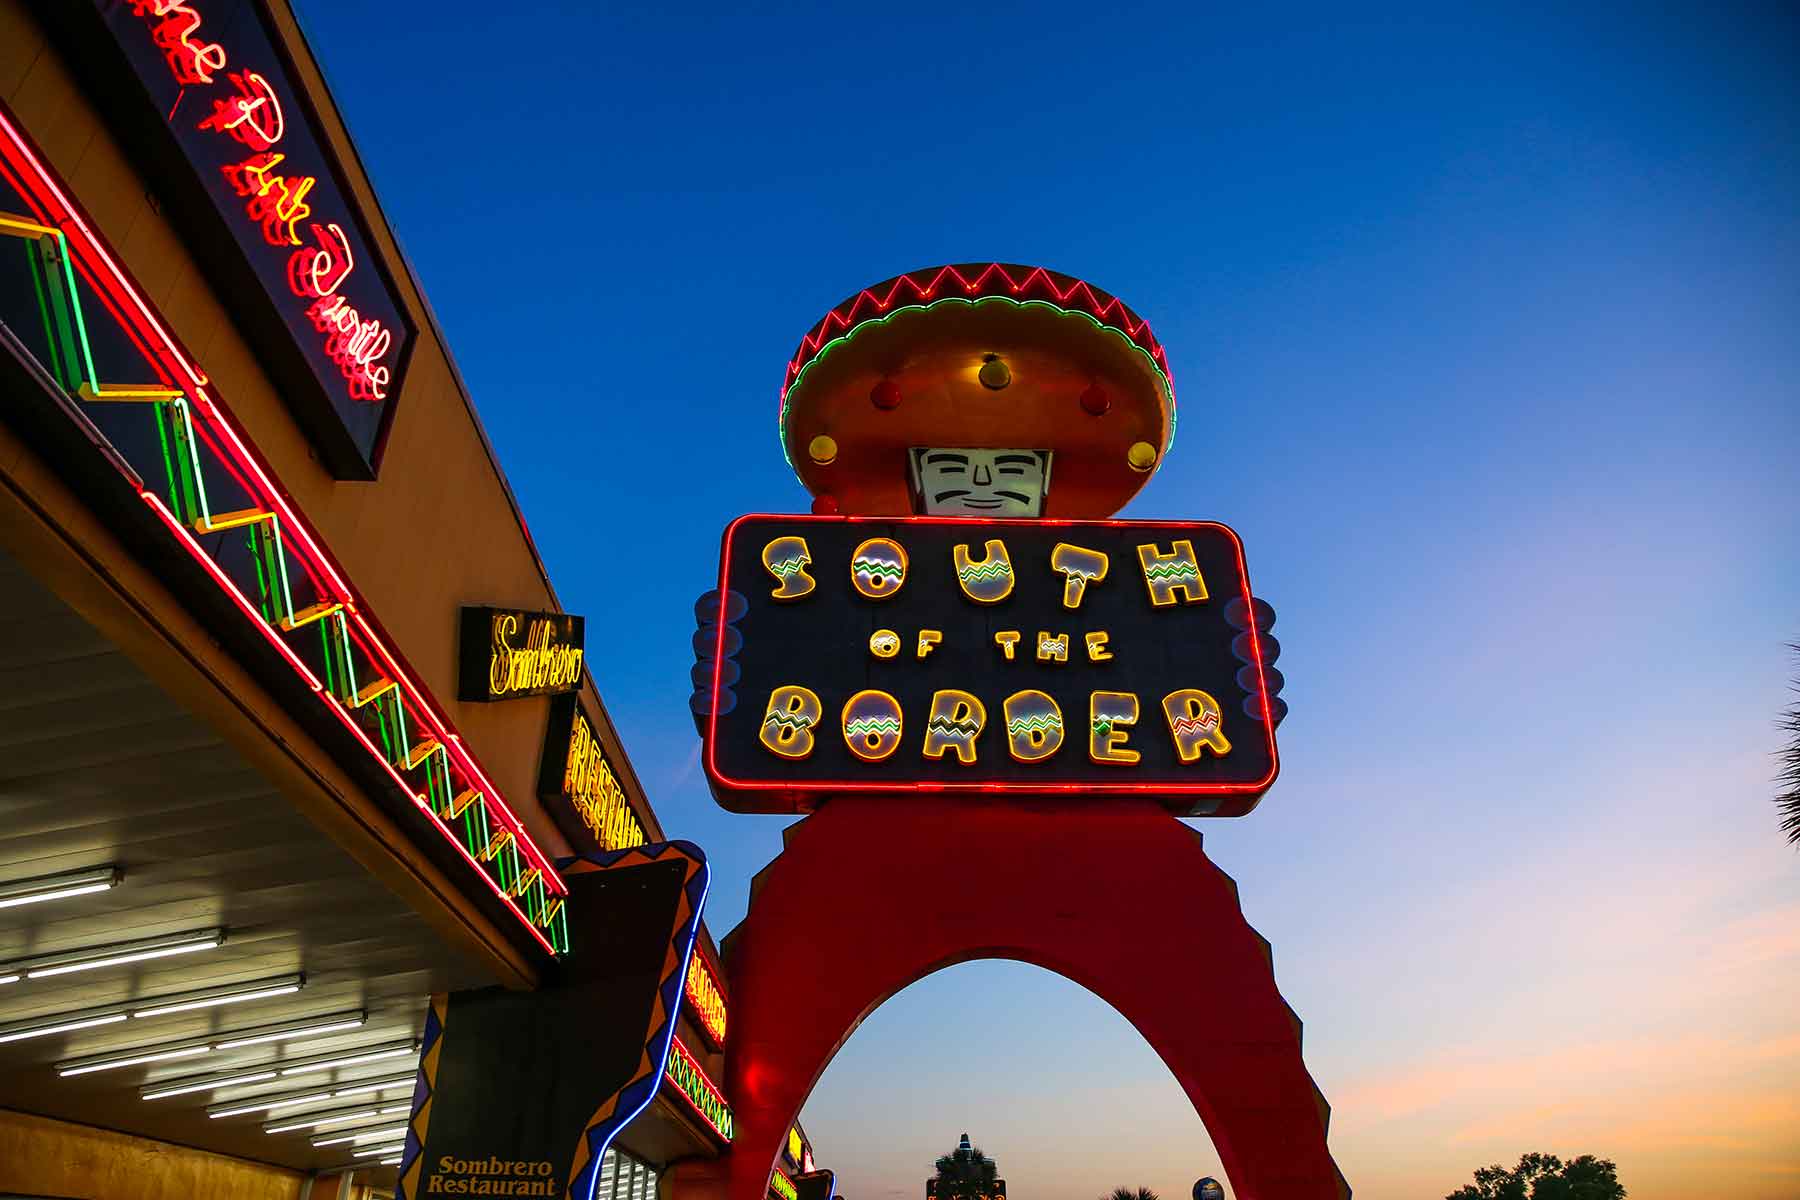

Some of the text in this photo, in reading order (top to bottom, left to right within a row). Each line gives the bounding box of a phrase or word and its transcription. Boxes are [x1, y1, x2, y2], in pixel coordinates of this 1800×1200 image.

[222, 72, 317, 247] Pink
[310, 223, 392, 400] Turtle
[761, 535, 1210, 609] SOUTH
[489, 614, 584, 695] Sombrero
[868, 628, 1114, 663] OF THE
[759, 684, 1233, 764] BORDER
[569, 714, 647, 850] RESTAUR
[426, 1174, 558, 1197] Restaurant
[438, 1155, 553, 1176] Sombrero
